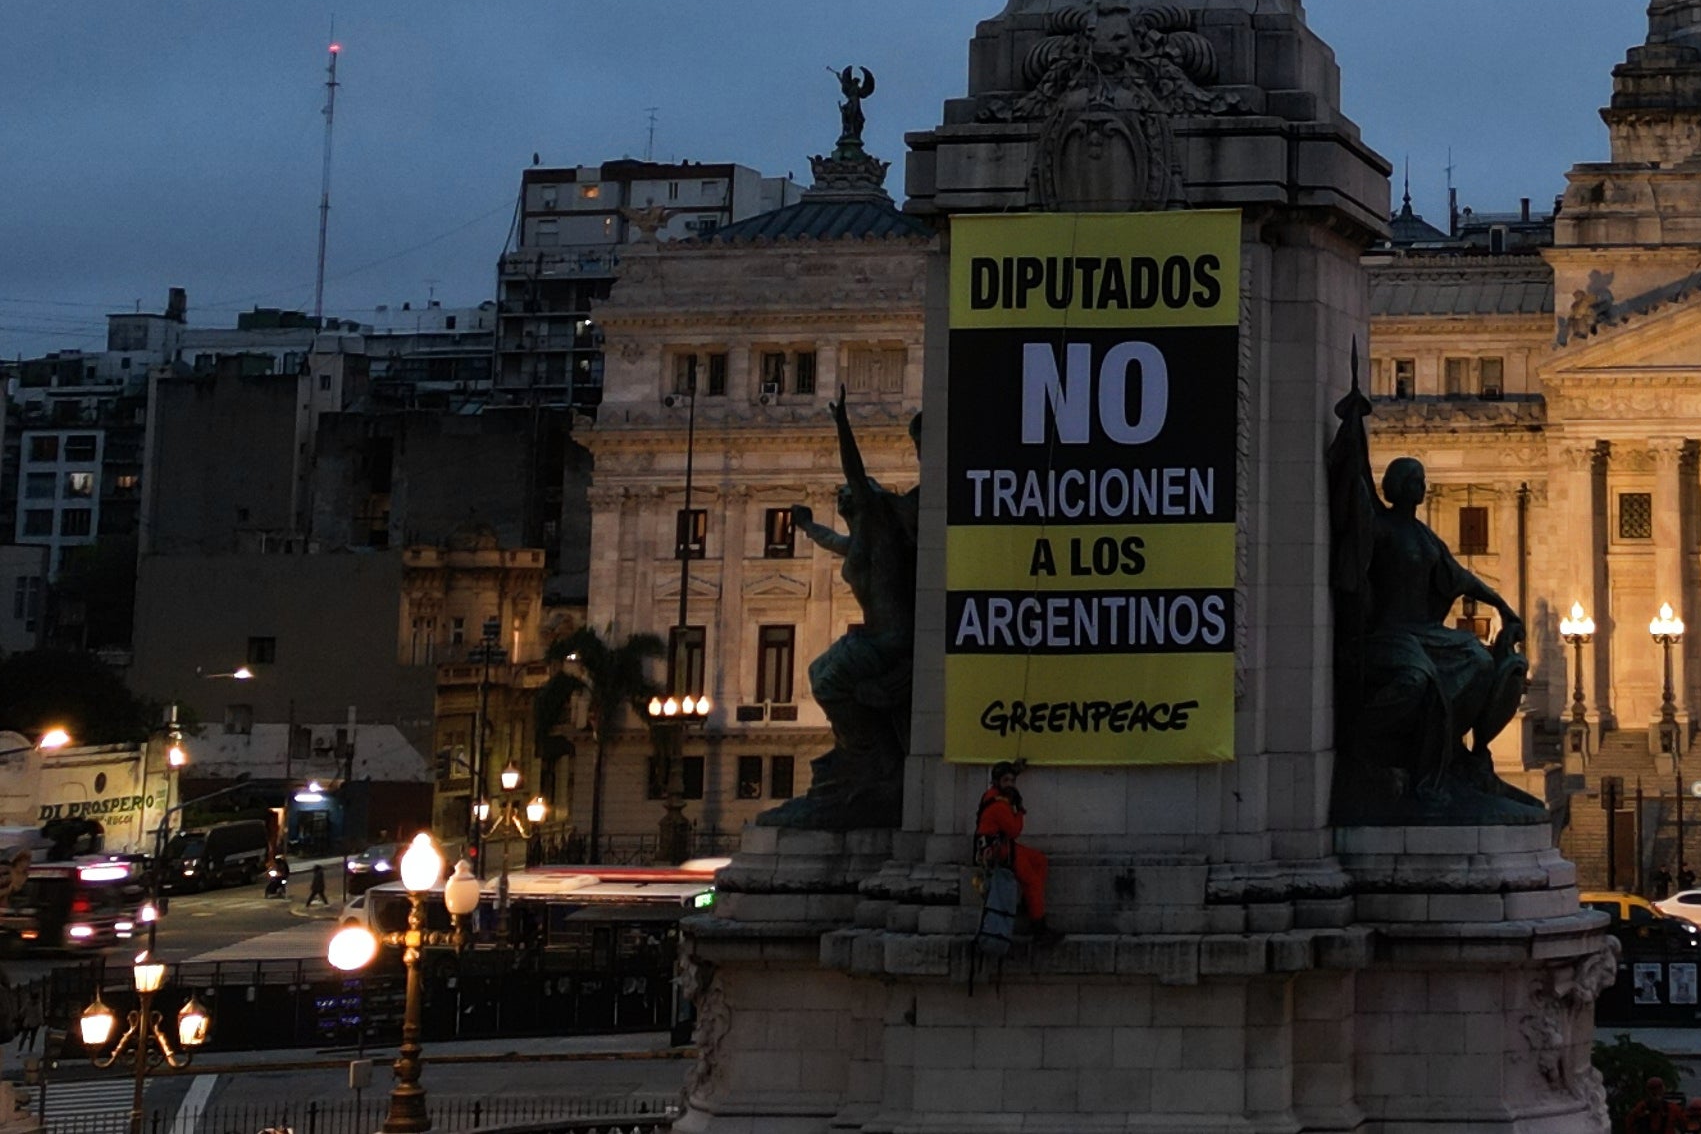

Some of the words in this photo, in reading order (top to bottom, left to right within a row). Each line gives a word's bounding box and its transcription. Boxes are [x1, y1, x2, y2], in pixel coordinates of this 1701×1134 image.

[970, 254, 1221, 309] DIPUTADOS
[1021, 341, 1169, 444] NO
[966, 467, 1215, 519] TRAICIONEN
[1029, 538, 1057, 577] A
[1070, 535, 1146, 576] LOS
[955, 594, 1227, 646] ARGENTINOS
[980, 699, 1198, 734] GREENPEACE
[38, 804, 62, 820] DI
[66, 795, 154, 818] PROSPERO
